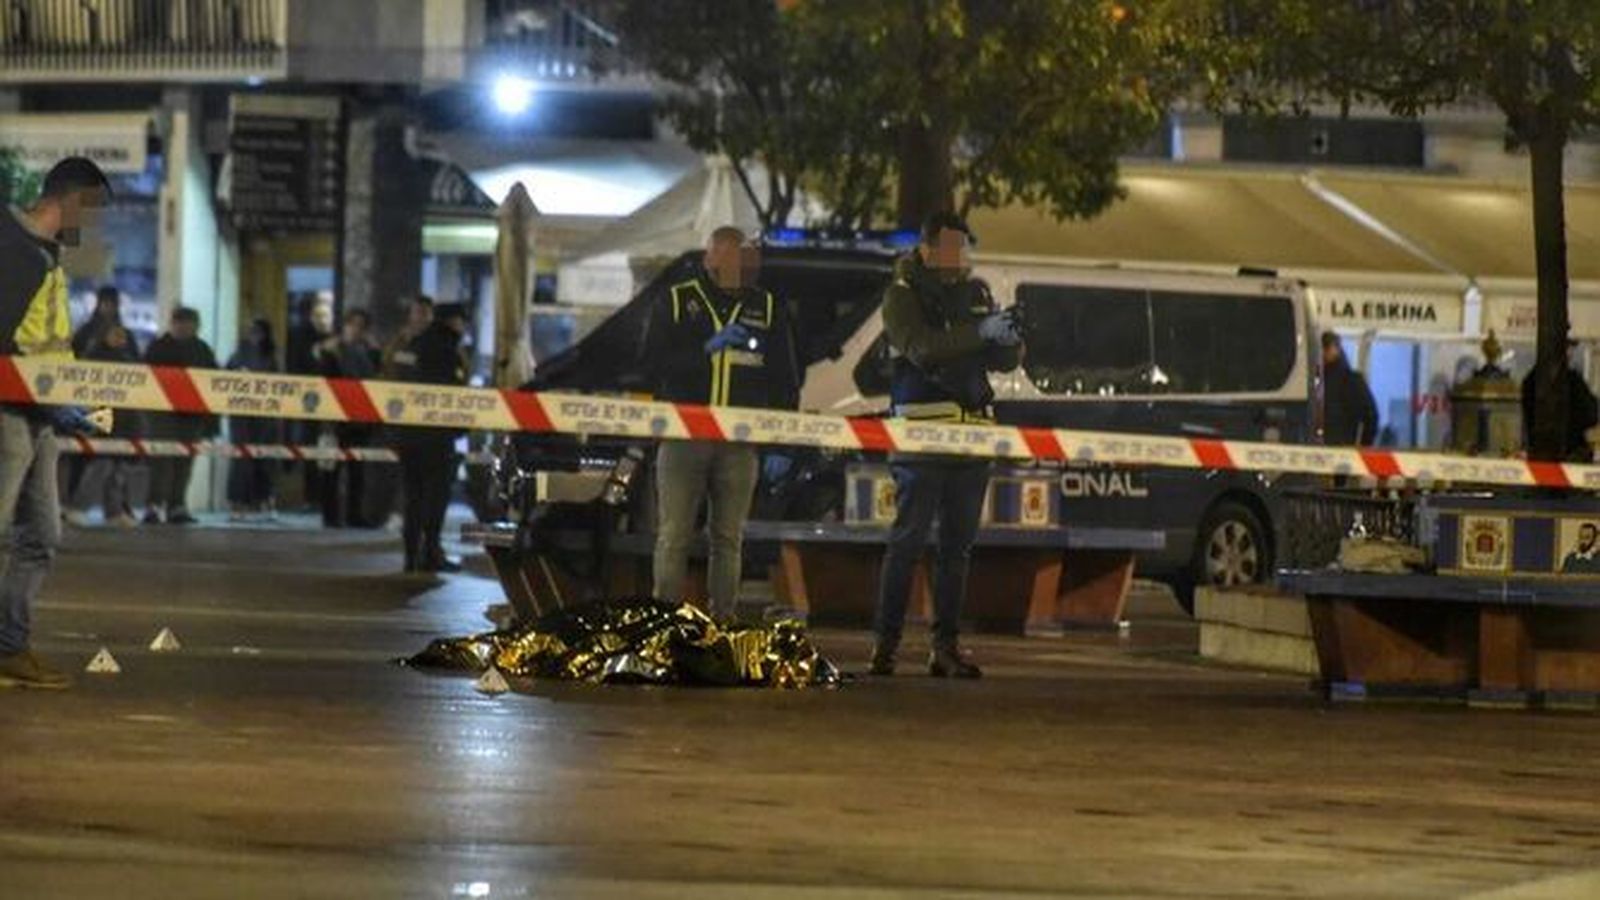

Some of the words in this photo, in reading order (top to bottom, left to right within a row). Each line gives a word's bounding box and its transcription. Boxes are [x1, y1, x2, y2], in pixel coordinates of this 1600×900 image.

[1331, 300, 1355, 318] LA
[1362, 301, 1437, 322] ESKINA
[1061, 471, 1149, 497] ONAL
